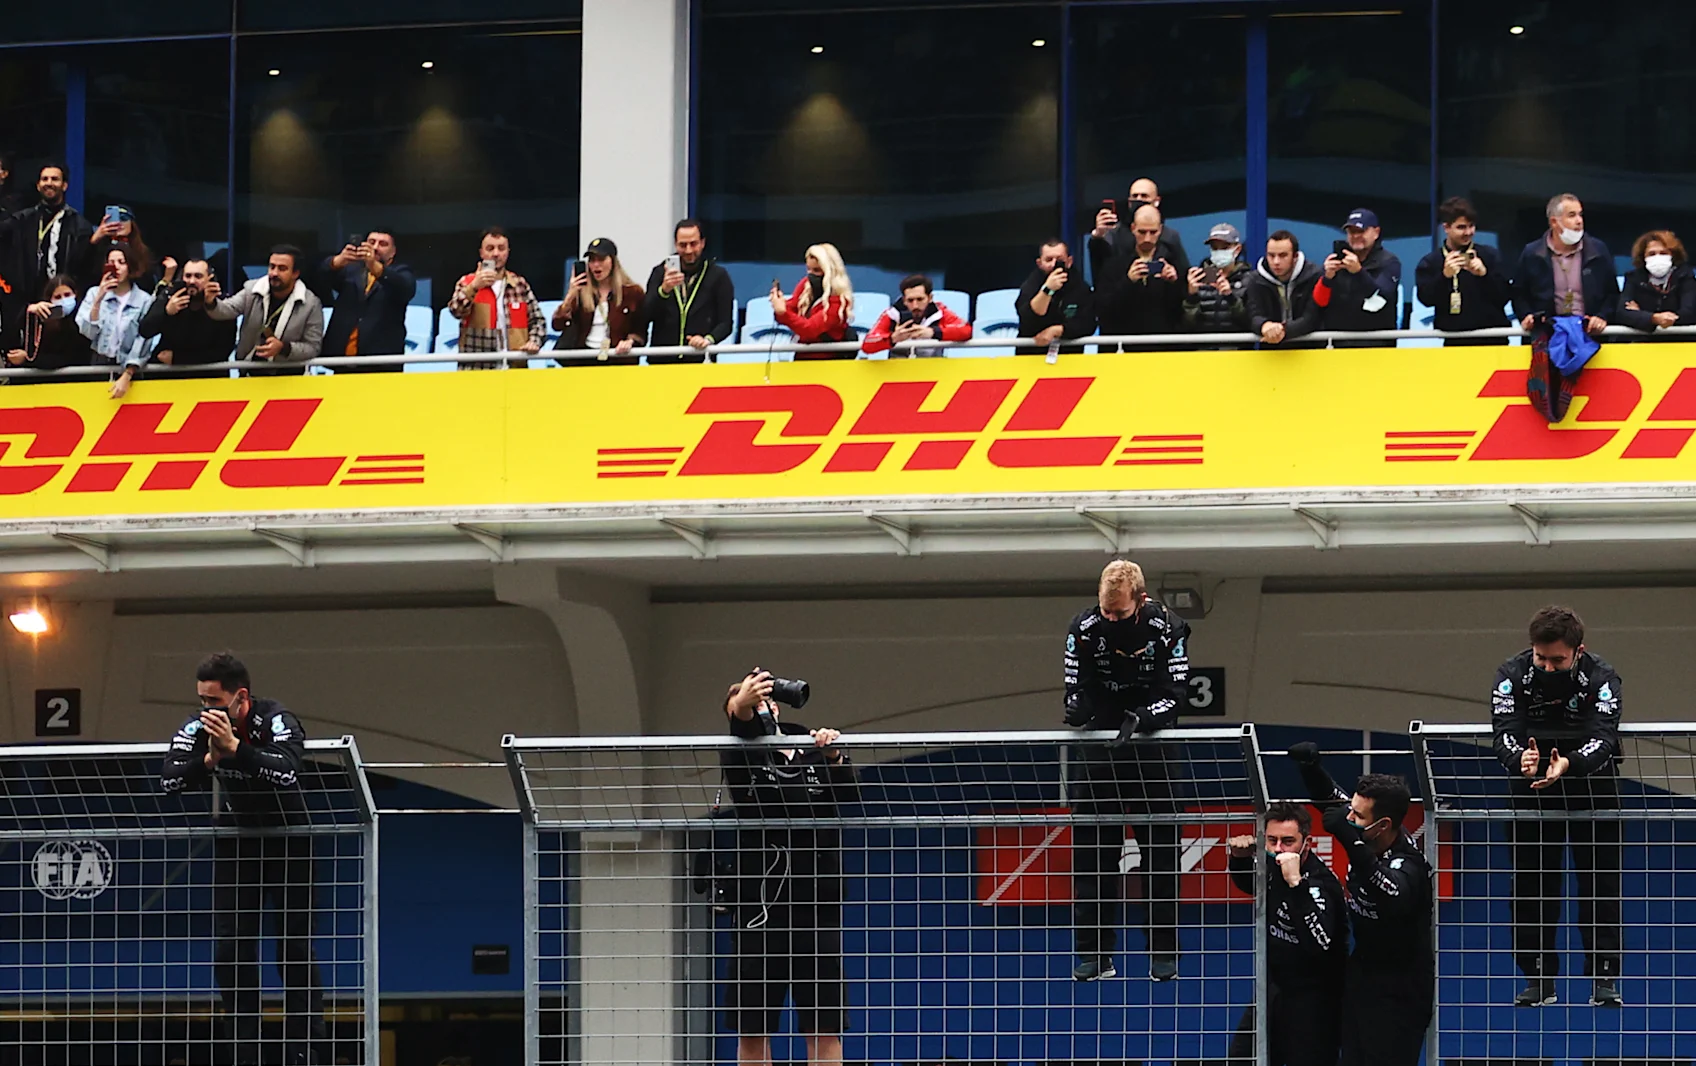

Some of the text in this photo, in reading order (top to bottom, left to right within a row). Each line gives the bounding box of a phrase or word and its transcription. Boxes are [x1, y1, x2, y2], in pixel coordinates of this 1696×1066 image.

[678, 376, 1121, 475] DHL
[1189, 676, 1213, 707] 3
[46, 698, 69, 727] 2
